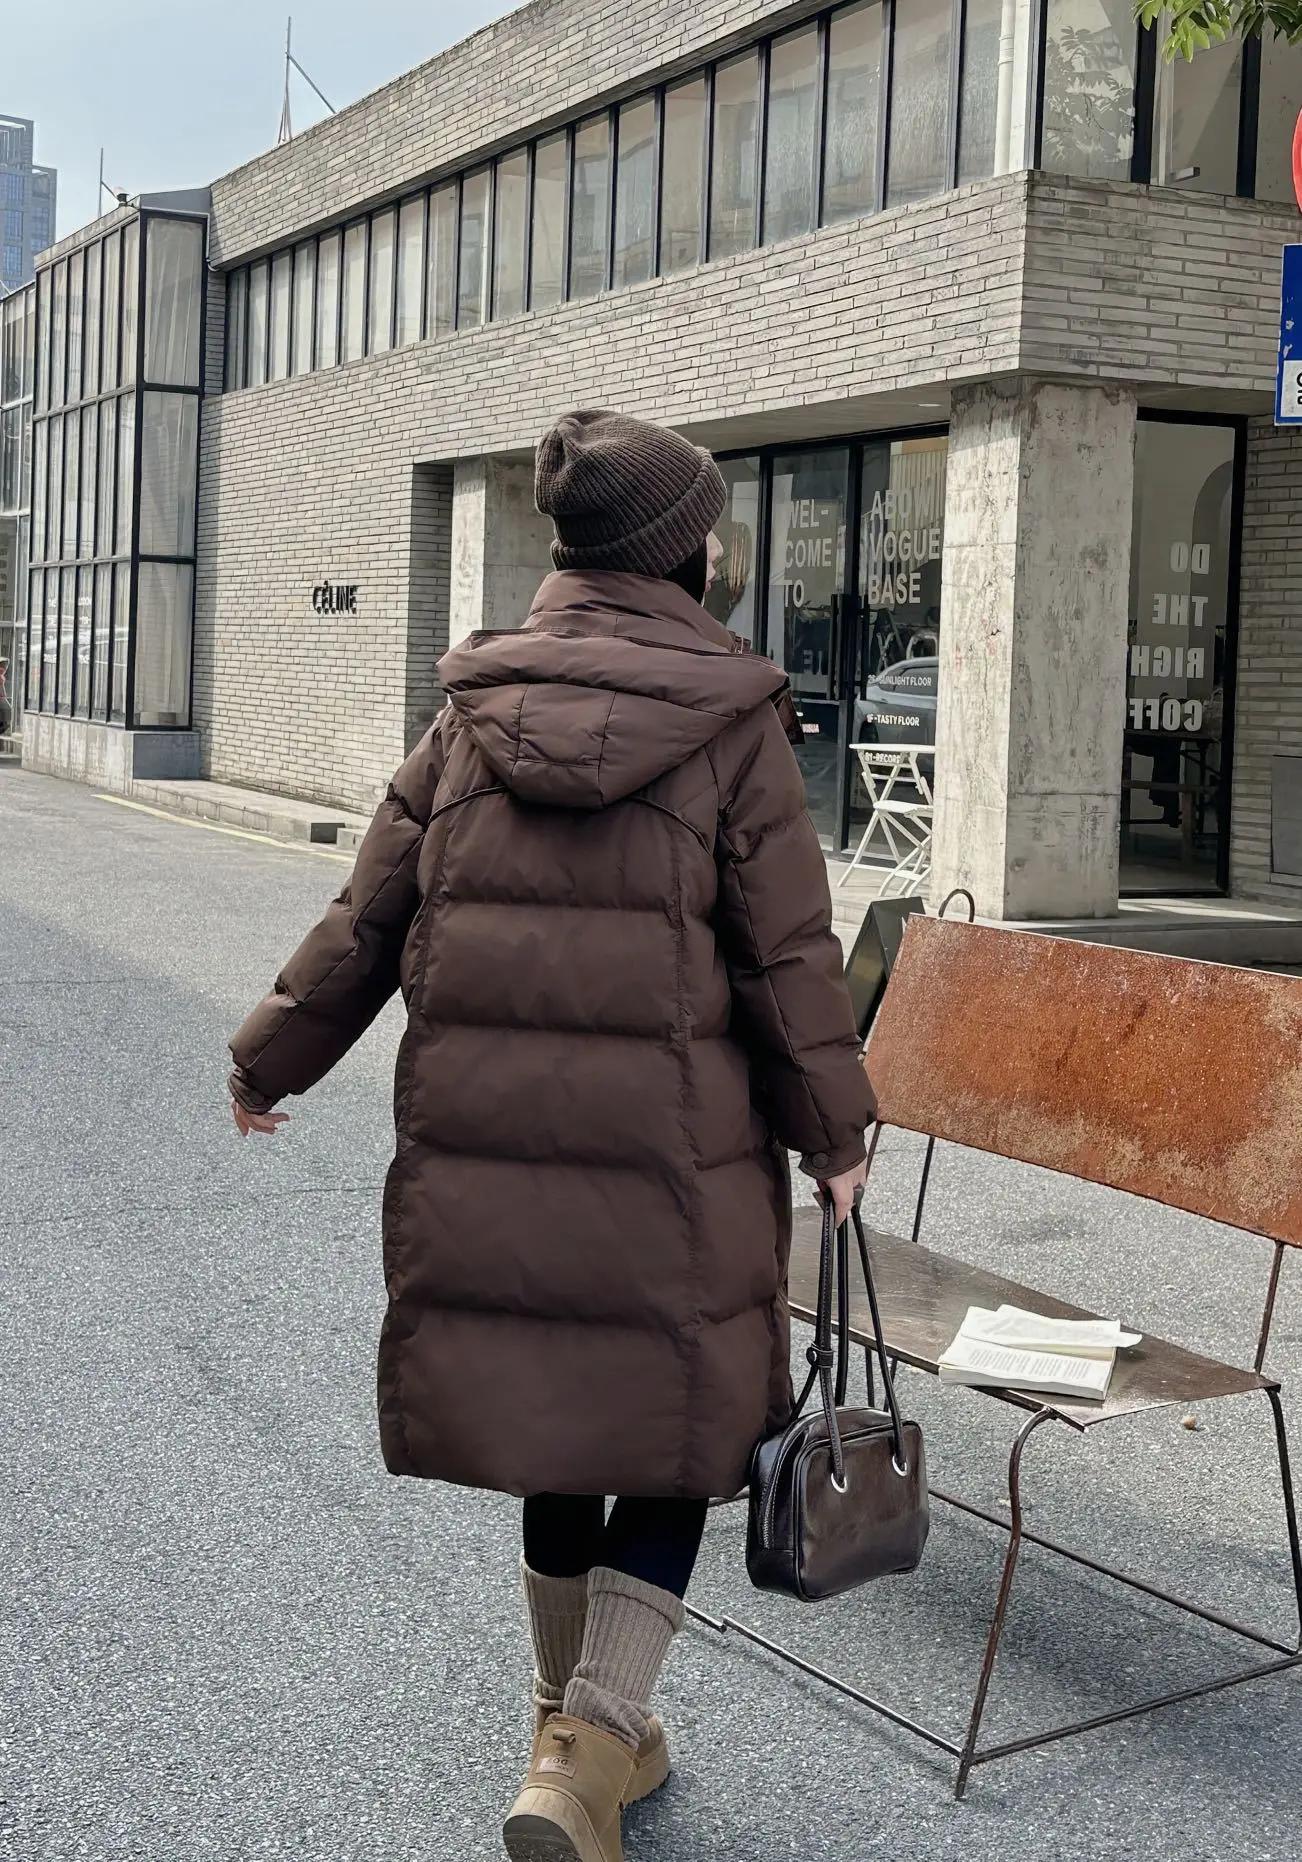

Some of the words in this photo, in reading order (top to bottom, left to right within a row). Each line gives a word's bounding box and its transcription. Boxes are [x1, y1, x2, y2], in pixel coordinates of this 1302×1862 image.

[784, 537, 833, 569] COME
[869, 528, 941, 562] VOGUE
[783, 579, 805, 608] TO
[867, 572, 921, 605] BASE
[910, 676, 932, 687] FLOOR
[897, 715, 920, 727] FLOOR
